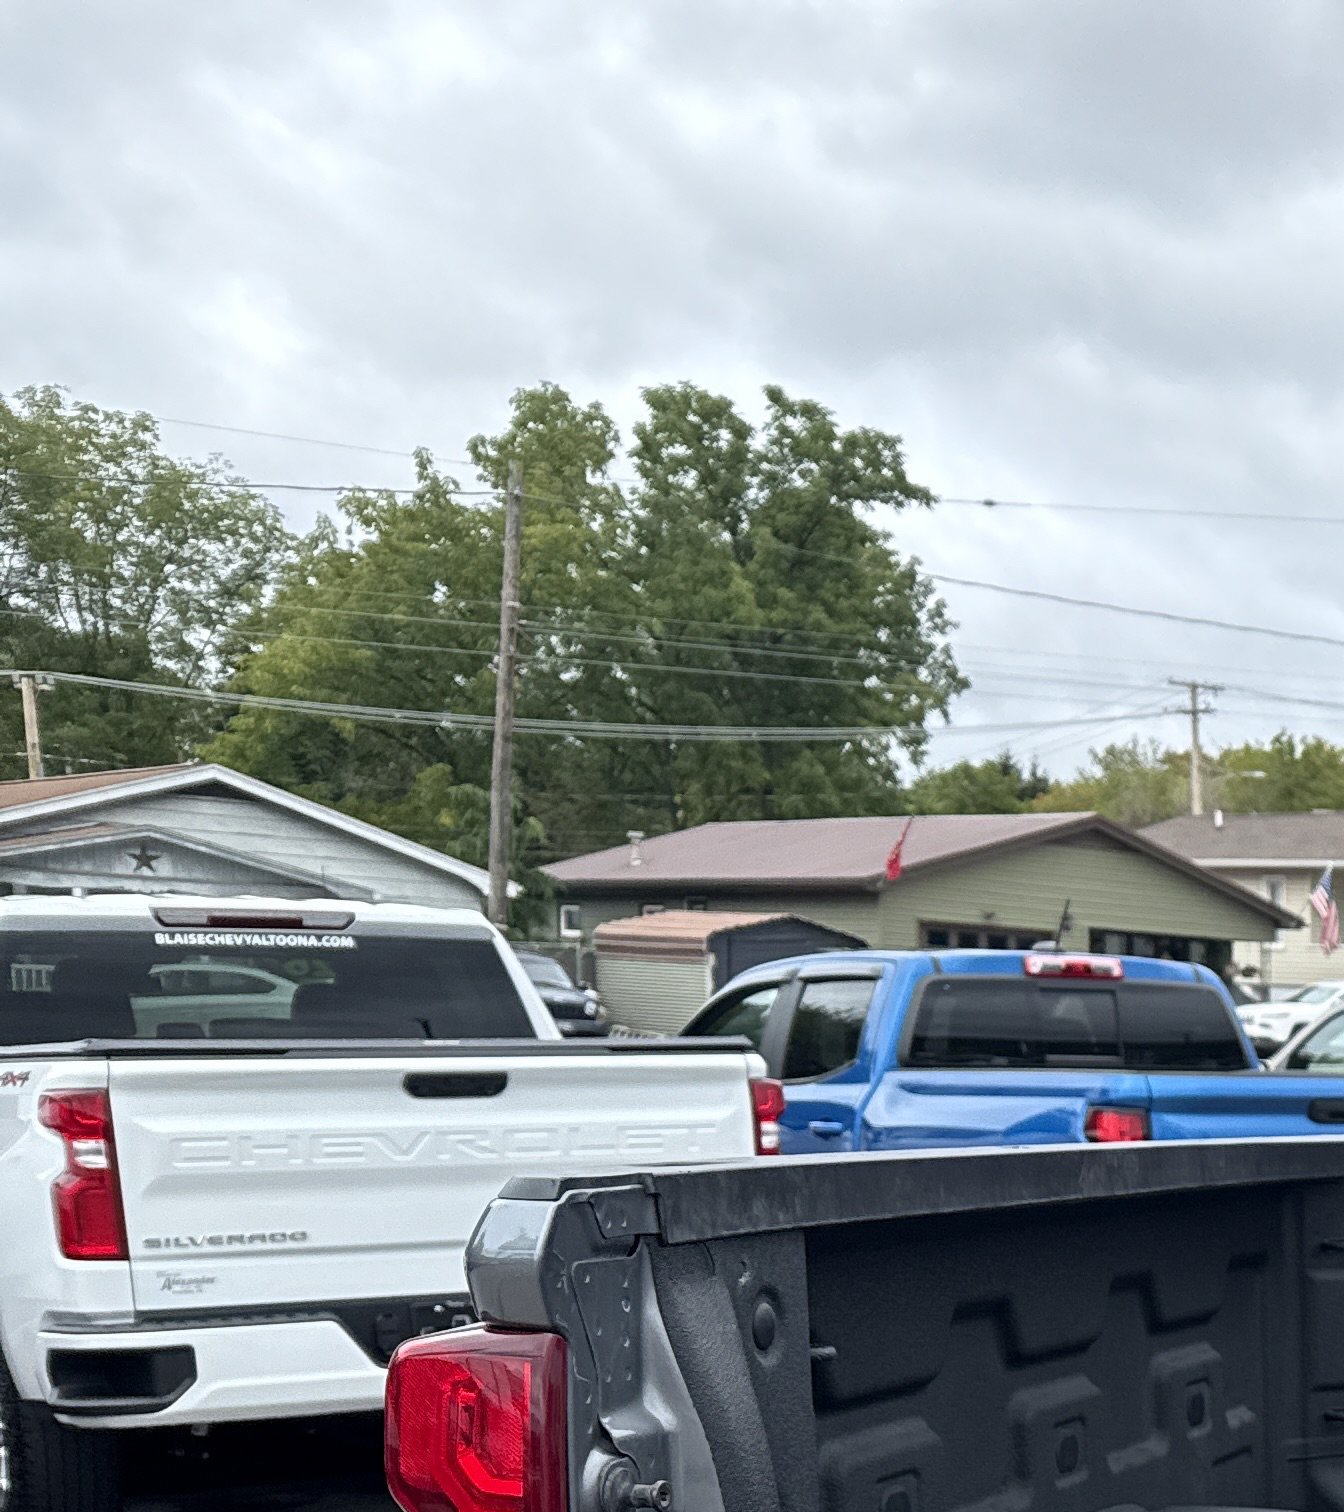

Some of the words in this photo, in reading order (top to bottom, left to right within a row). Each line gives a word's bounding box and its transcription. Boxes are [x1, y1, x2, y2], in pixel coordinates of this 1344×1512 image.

[155, 932, 355, 948] BLAISECHEVYALTOONA.COM
[170, 1127, 718, 1168] CHEVROLET
[142, 1231, 308, 1249] SILVERADO
